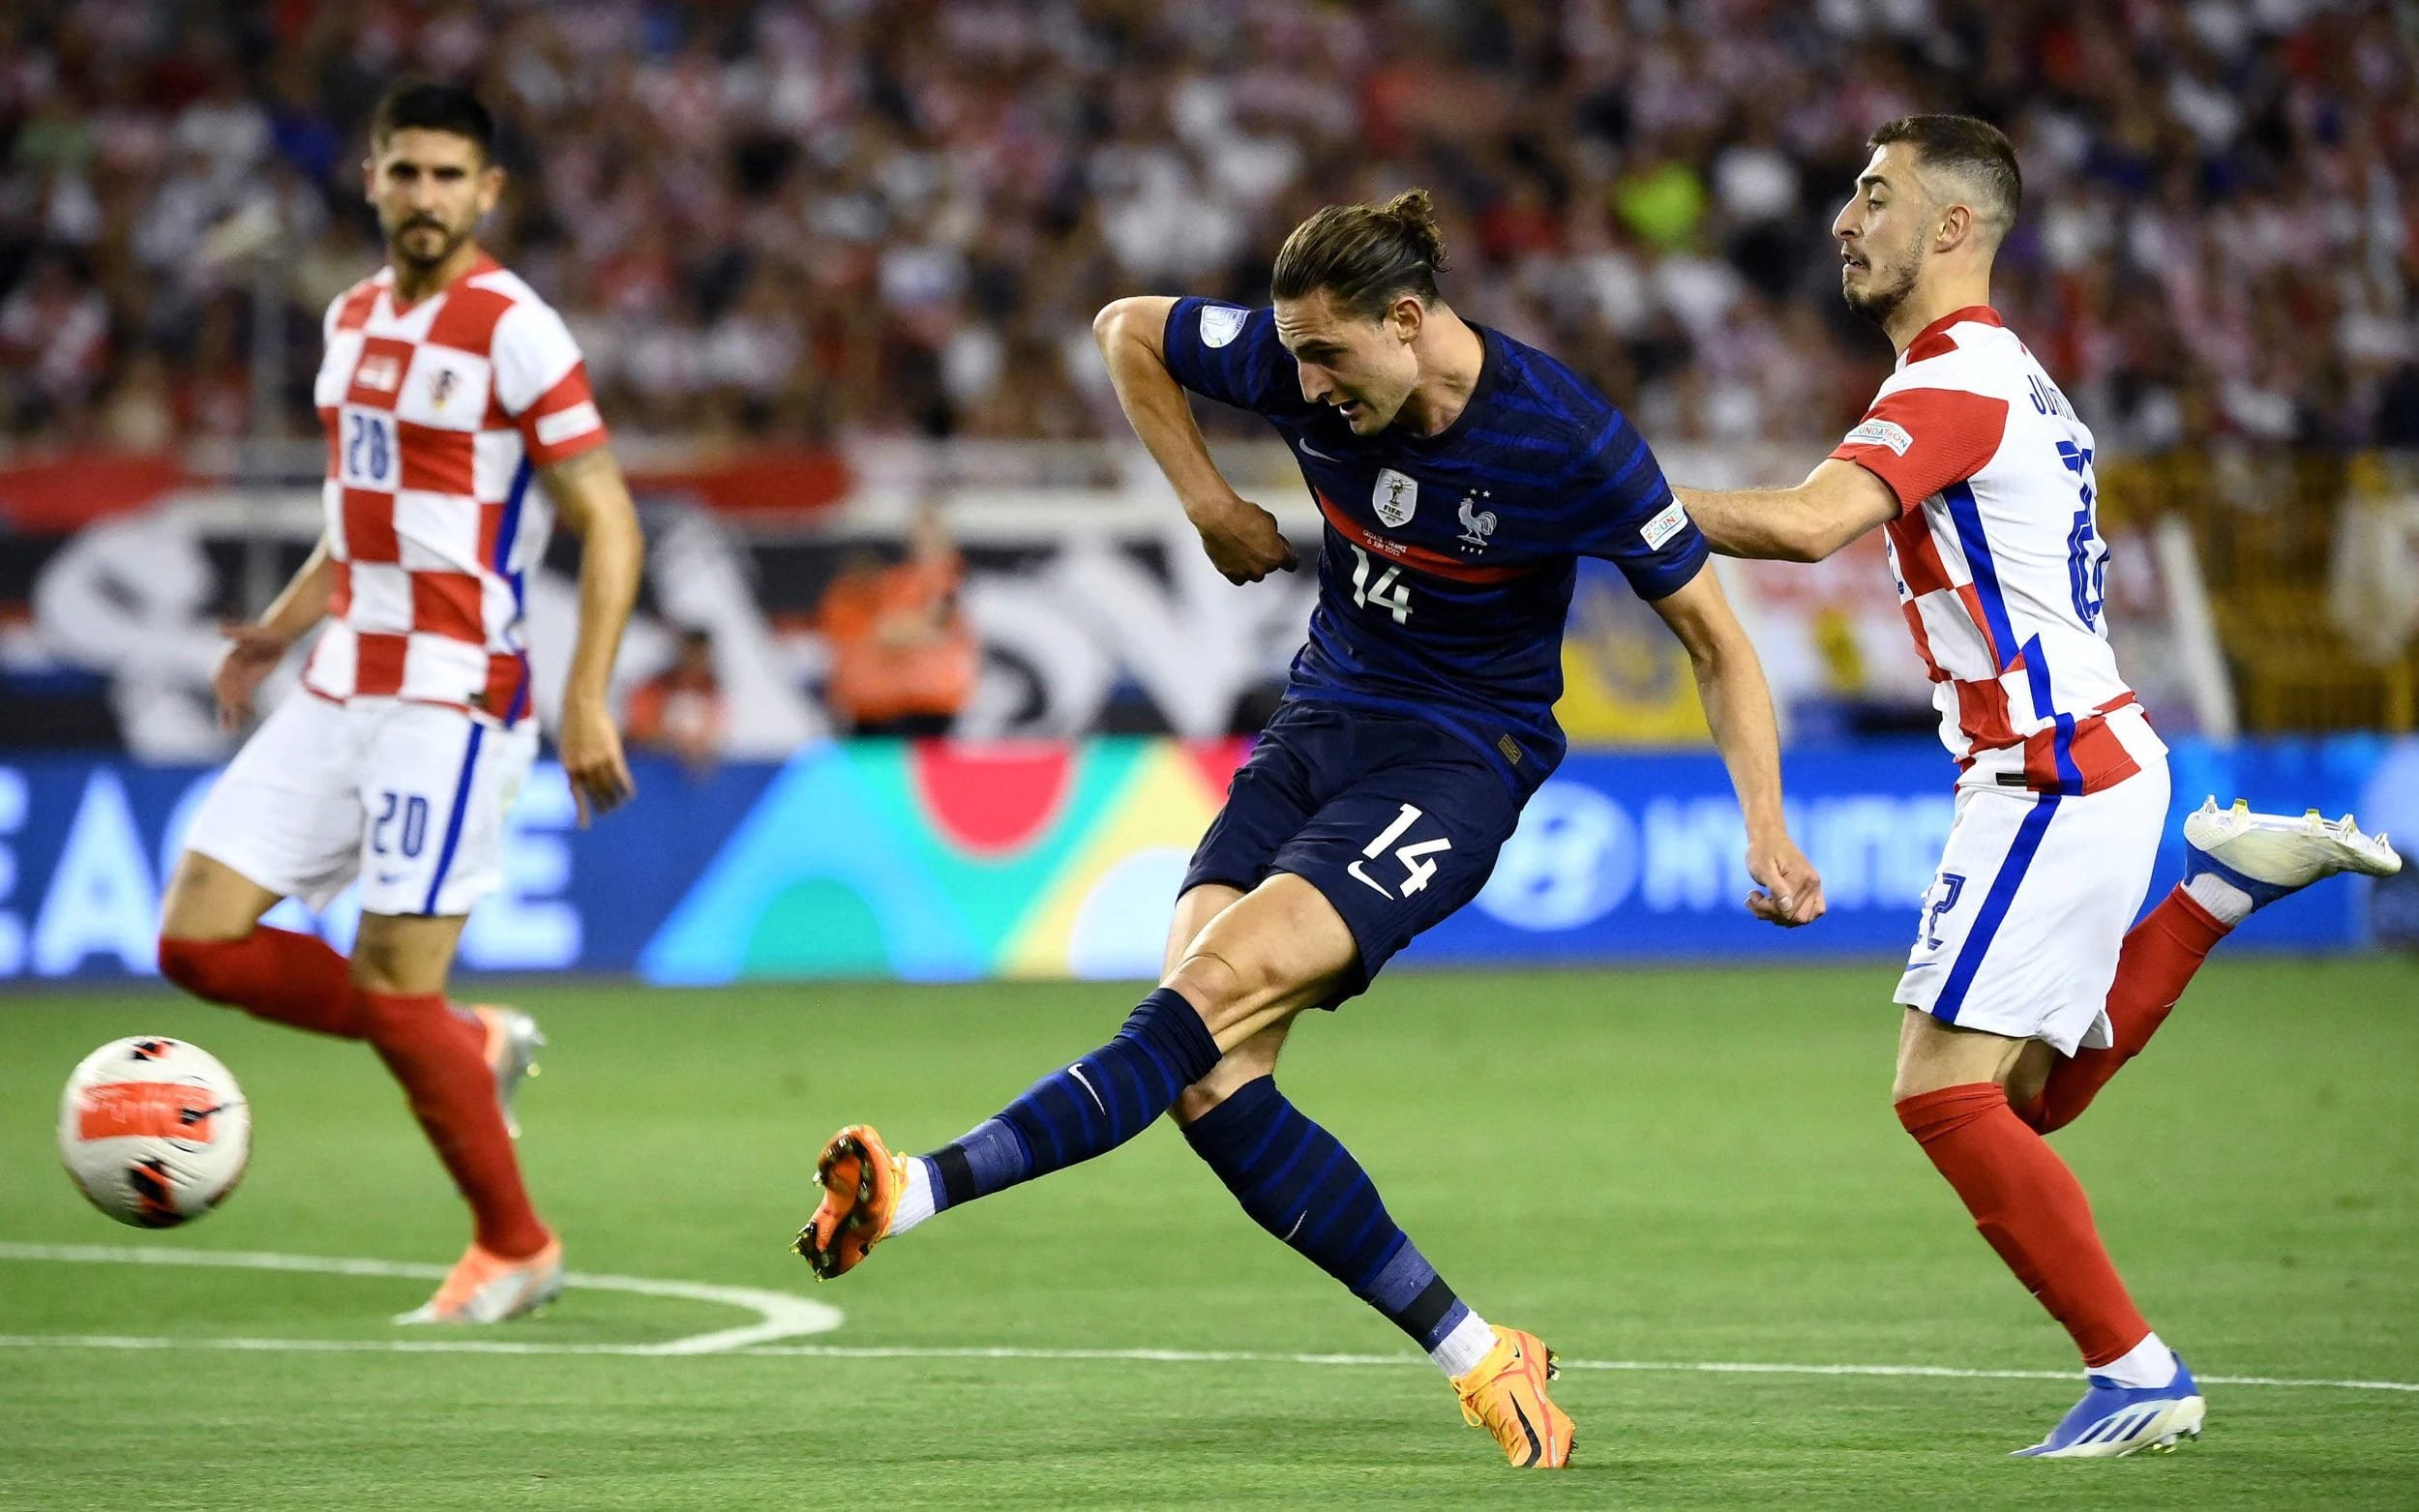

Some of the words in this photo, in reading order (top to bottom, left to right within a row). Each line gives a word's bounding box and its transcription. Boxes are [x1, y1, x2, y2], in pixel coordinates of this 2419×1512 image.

[1384, 504, 1402, 517] FIFA
[1351, 544, 1413, 625] 14
[1384, 545, 1401, 557] 2022
[372, 790, 429, 858] 20
[1362, 803, 1451, 898] 14
